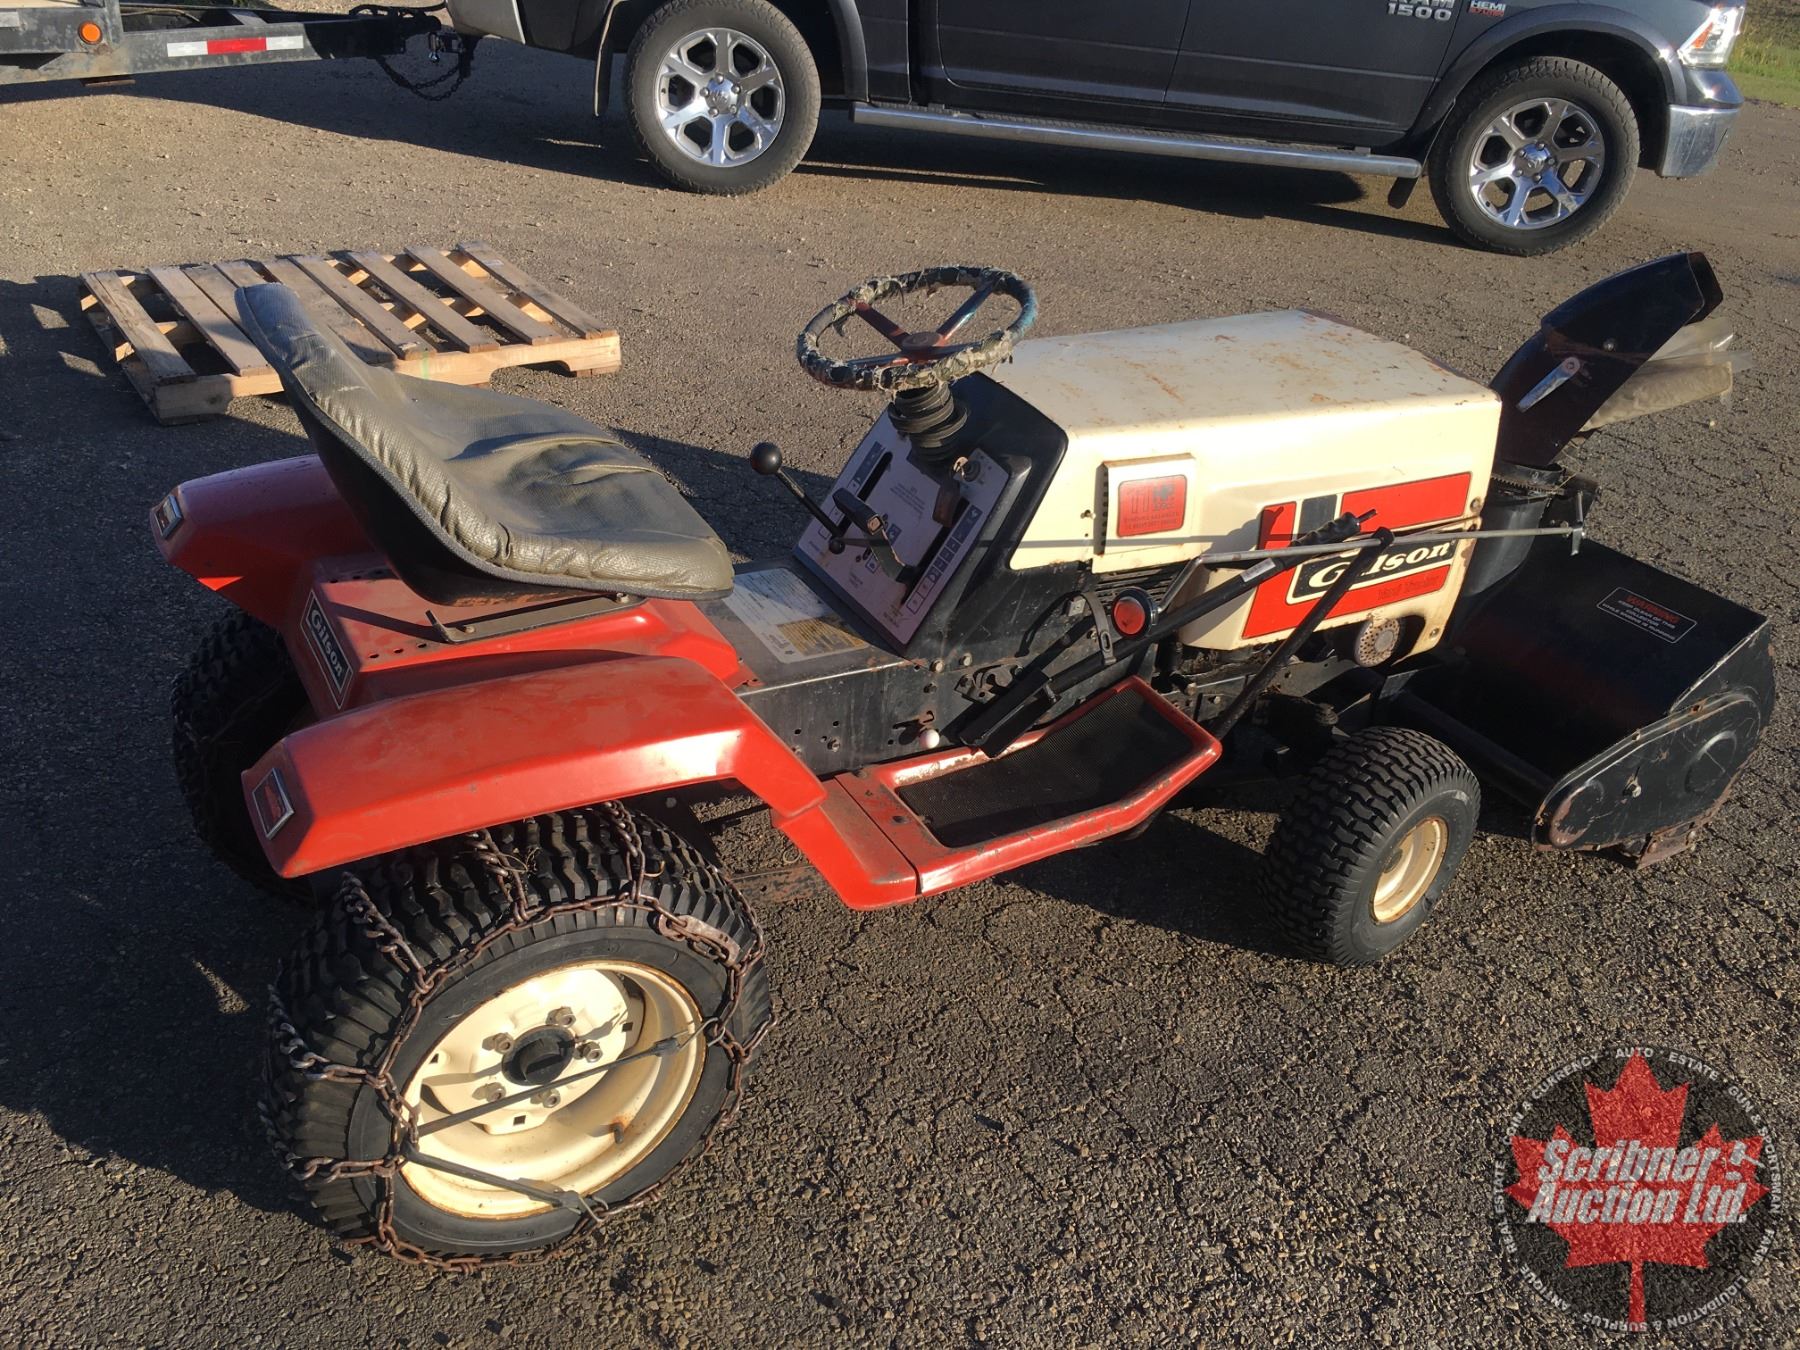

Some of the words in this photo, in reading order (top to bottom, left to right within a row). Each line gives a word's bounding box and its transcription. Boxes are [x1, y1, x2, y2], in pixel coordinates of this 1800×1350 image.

[1388, 2, 1452, 21] 1500
[1470, 0, 1507, 11] HEMI
[1308, 542, 1450, 588] Glson
[311, 609, 343, 678] Gilson
